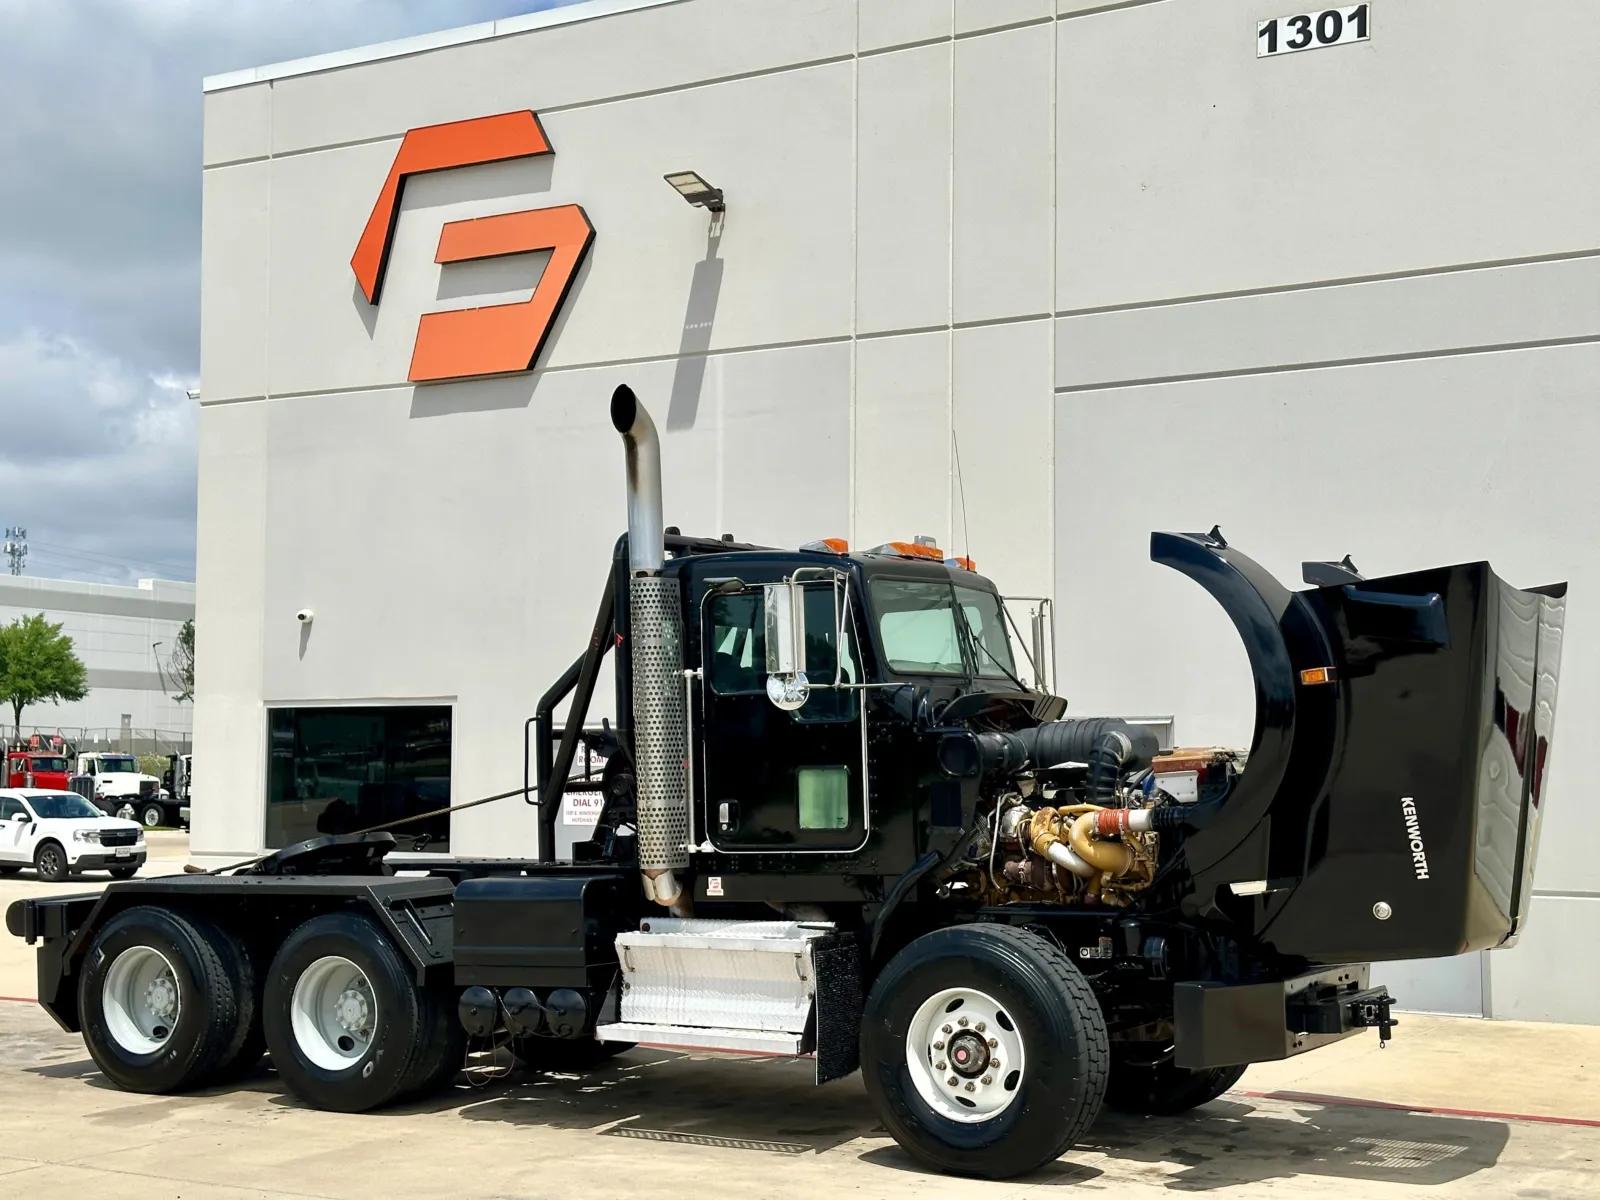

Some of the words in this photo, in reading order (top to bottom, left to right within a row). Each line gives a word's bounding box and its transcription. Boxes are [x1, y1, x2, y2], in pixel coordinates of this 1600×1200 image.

[1259, 4, 1367, 53] 1301
[579, 756, 604, 764] ROM
[573, 799, 591, 807] DIAL
[594, 799, 603, 807] 91
[1401, 797, 1429, 879] KENWORTH
